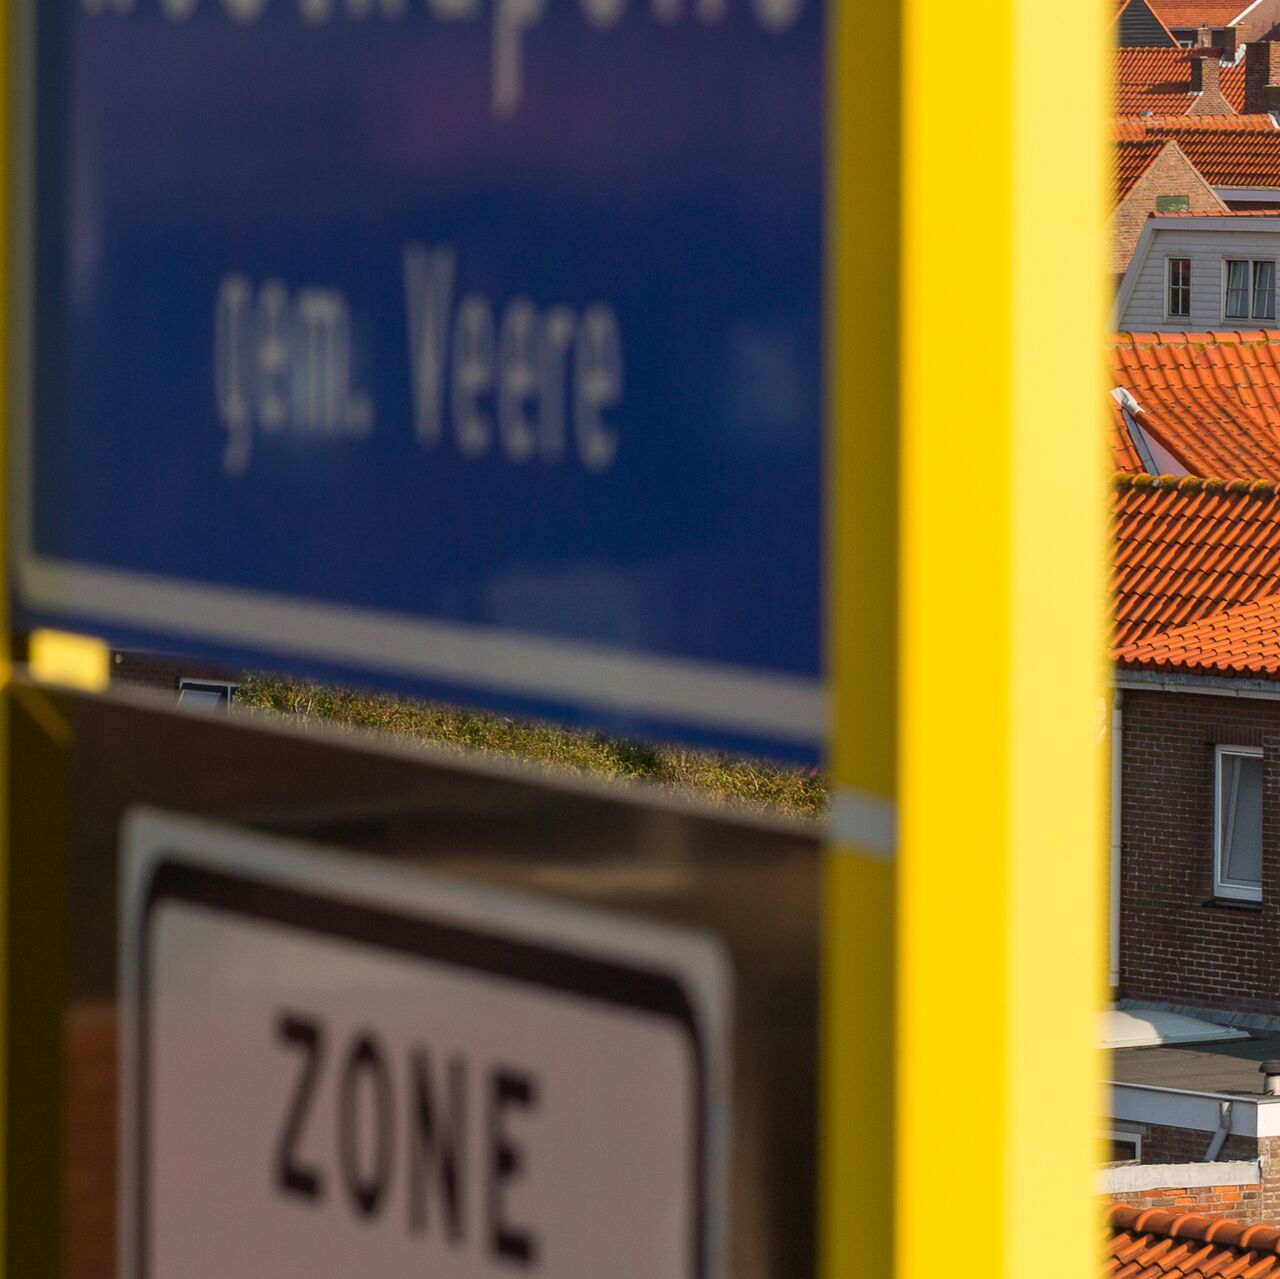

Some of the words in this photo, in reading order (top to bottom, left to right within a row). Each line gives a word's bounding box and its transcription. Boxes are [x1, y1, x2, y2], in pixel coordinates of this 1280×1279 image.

[213, 270, 374, 477] gem.
[401, 240, 624, 475] Veere
[273, 1006, 539, 1268] ZONE
